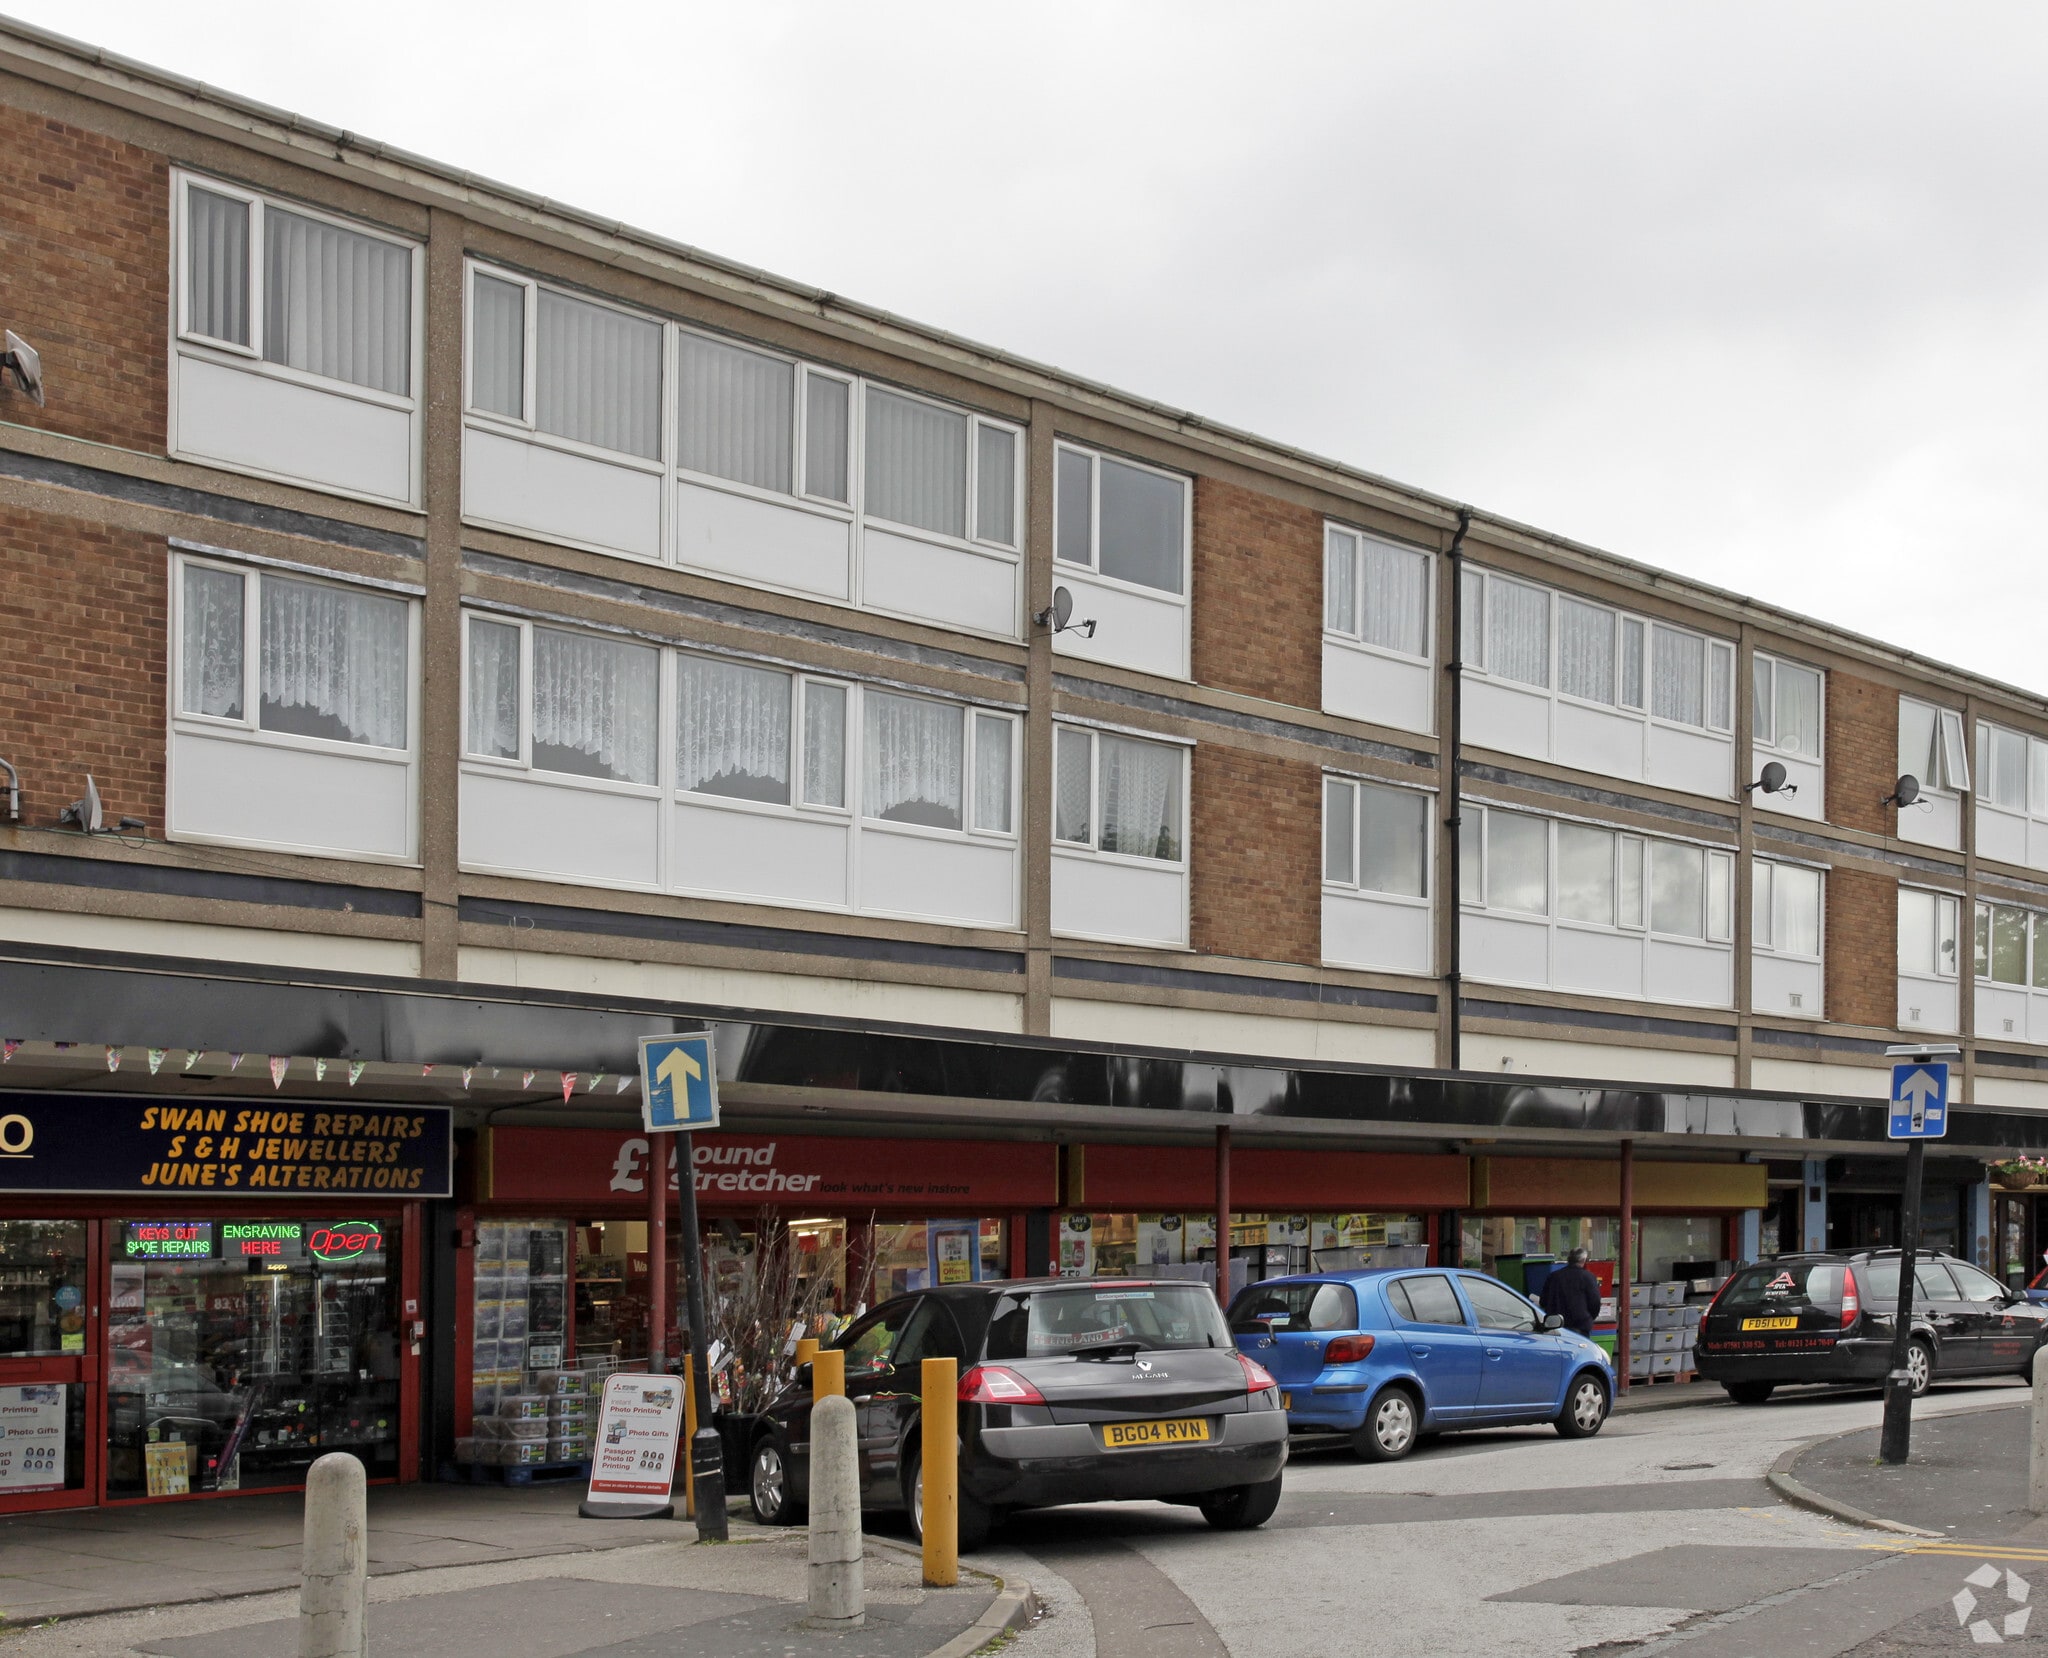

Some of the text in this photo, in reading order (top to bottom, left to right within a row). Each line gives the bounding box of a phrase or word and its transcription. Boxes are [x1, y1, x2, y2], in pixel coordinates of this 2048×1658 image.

[140, 1107, 425, 1138] SWAN SHOE REPAIRS
[168, 1136, 402, 1163] S & H JEWELLERS
[141, 1162, 424, 1189] JUNE'S ALTERATIONS
[820, 1182, 970, 1194] look what's new instore
[138, 1228, 199, 1240] KEYS CUT
[223, 1225, 301, 1239] ENGRAVING
[162, 1241, 210, 1253] REPAIRS
[241, 1241, 282, 1255] HERE
[309, 1229, 383, 1255] Open
[1050, 1334, 1103, 1345] ENGLAND
[2, 1406, 38, 1414] Printing
[633, 1407, 662, 1415] Printing
[8, 1427, 59, 1436] Photo Gifts
[1111, 1422, 1202, 1442] BG04 RVN
[602, 1462, 631, 1471] Printing
